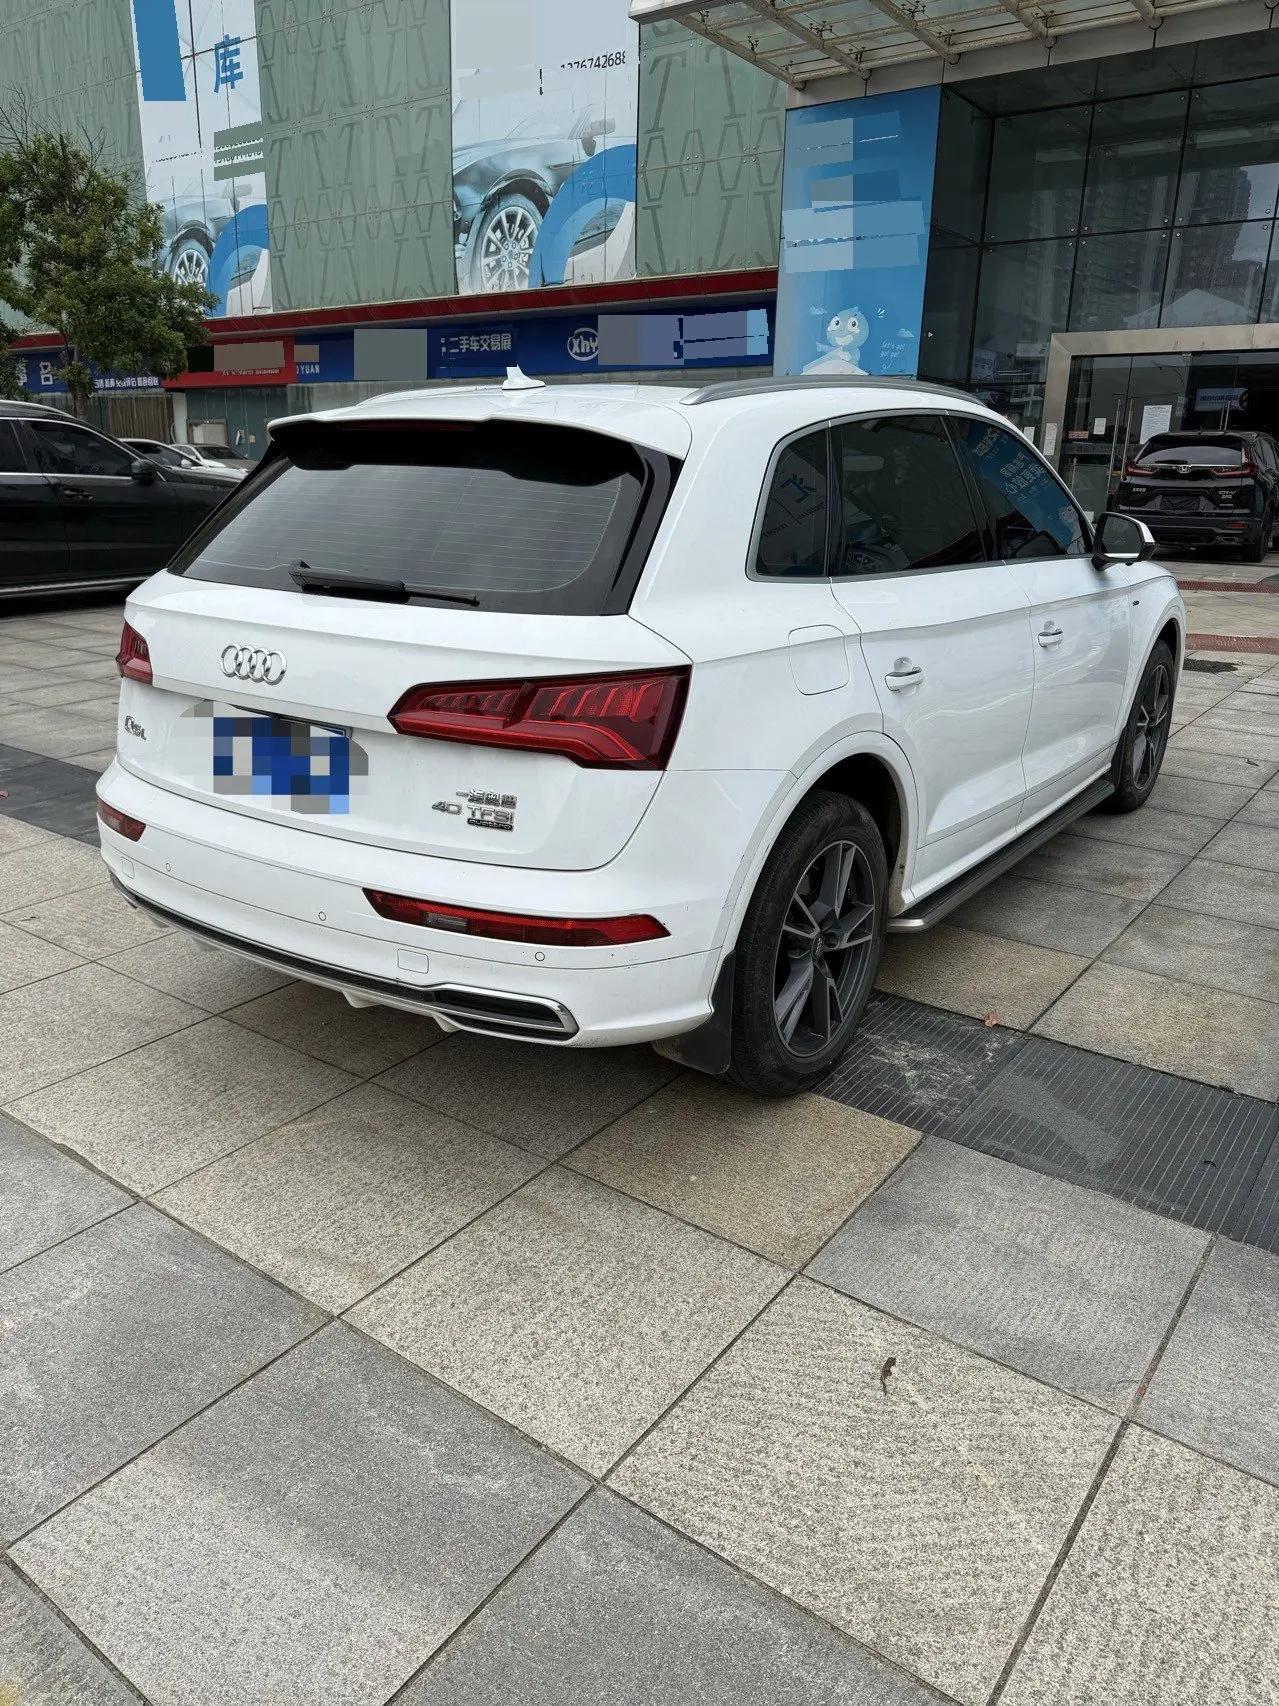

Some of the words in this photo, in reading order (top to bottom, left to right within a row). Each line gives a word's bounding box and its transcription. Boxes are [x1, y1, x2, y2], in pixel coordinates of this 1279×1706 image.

[214, 34, 243, 93] 库
[448, 332, 512, 353] 二手车交易展
[296, 364, 320, 376] YUAN
[432, 800, 462, 815] 40
[467, 804, 515, 825] TFSI
[467, 818, 514, 832] quattro
